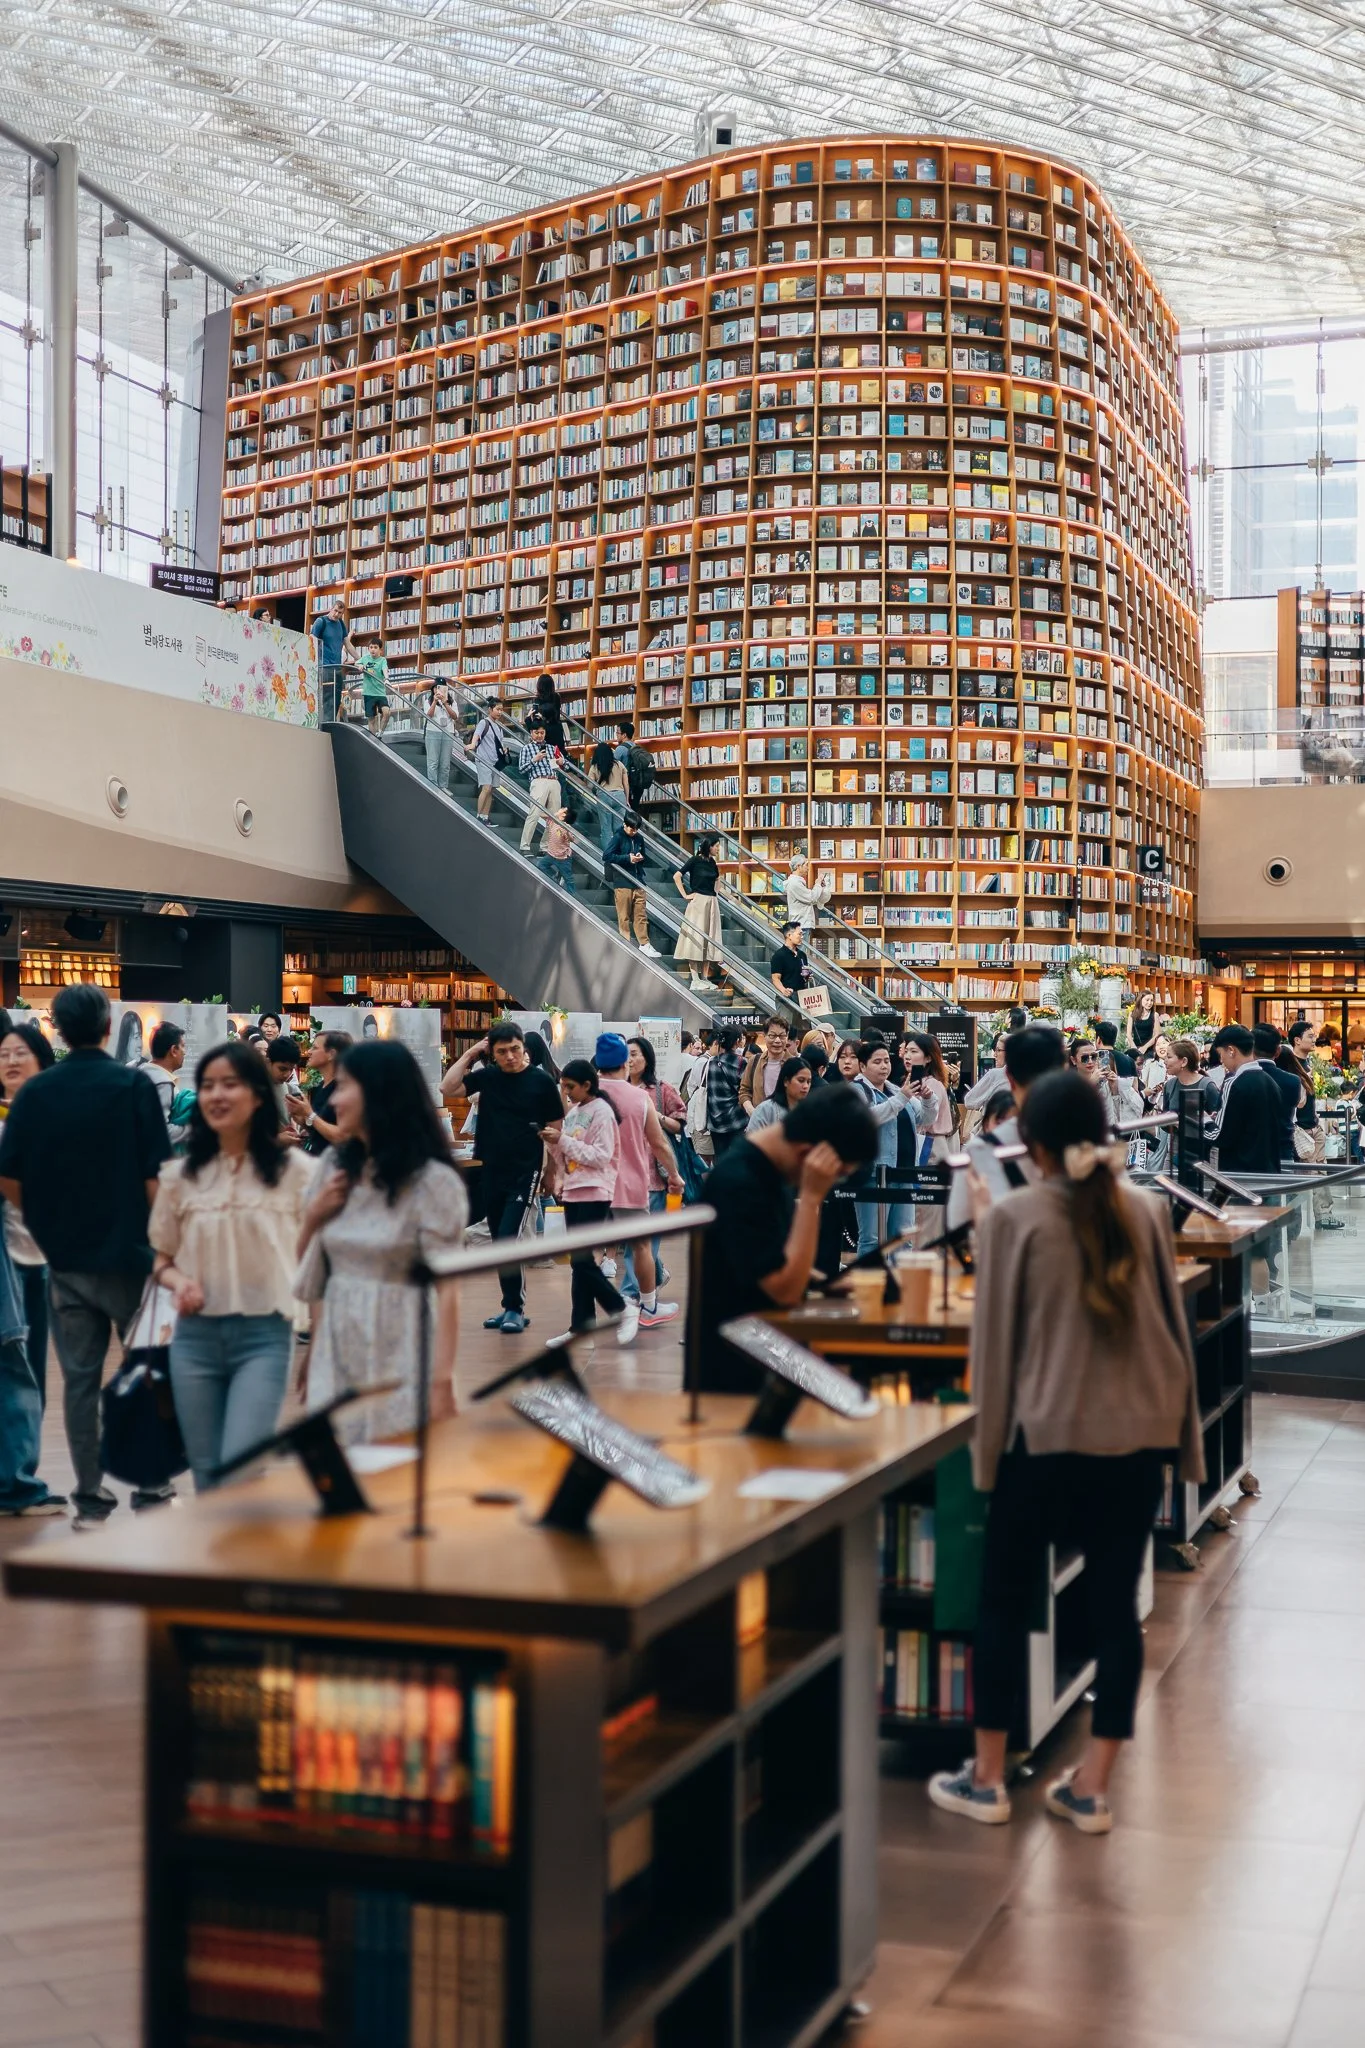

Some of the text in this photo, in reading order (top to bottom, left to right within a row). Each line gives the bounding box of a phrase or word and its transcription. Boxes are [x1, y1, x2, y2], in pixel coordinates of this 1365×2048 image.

[196, 576, 214, 587] 라운지
[143, 624, 183, 653] 별마당도서관
[1145, 849, 1160, 869] C
[1142, 887, 1160, 897] 실용
[803, 994, 823, 1006] MUJI
